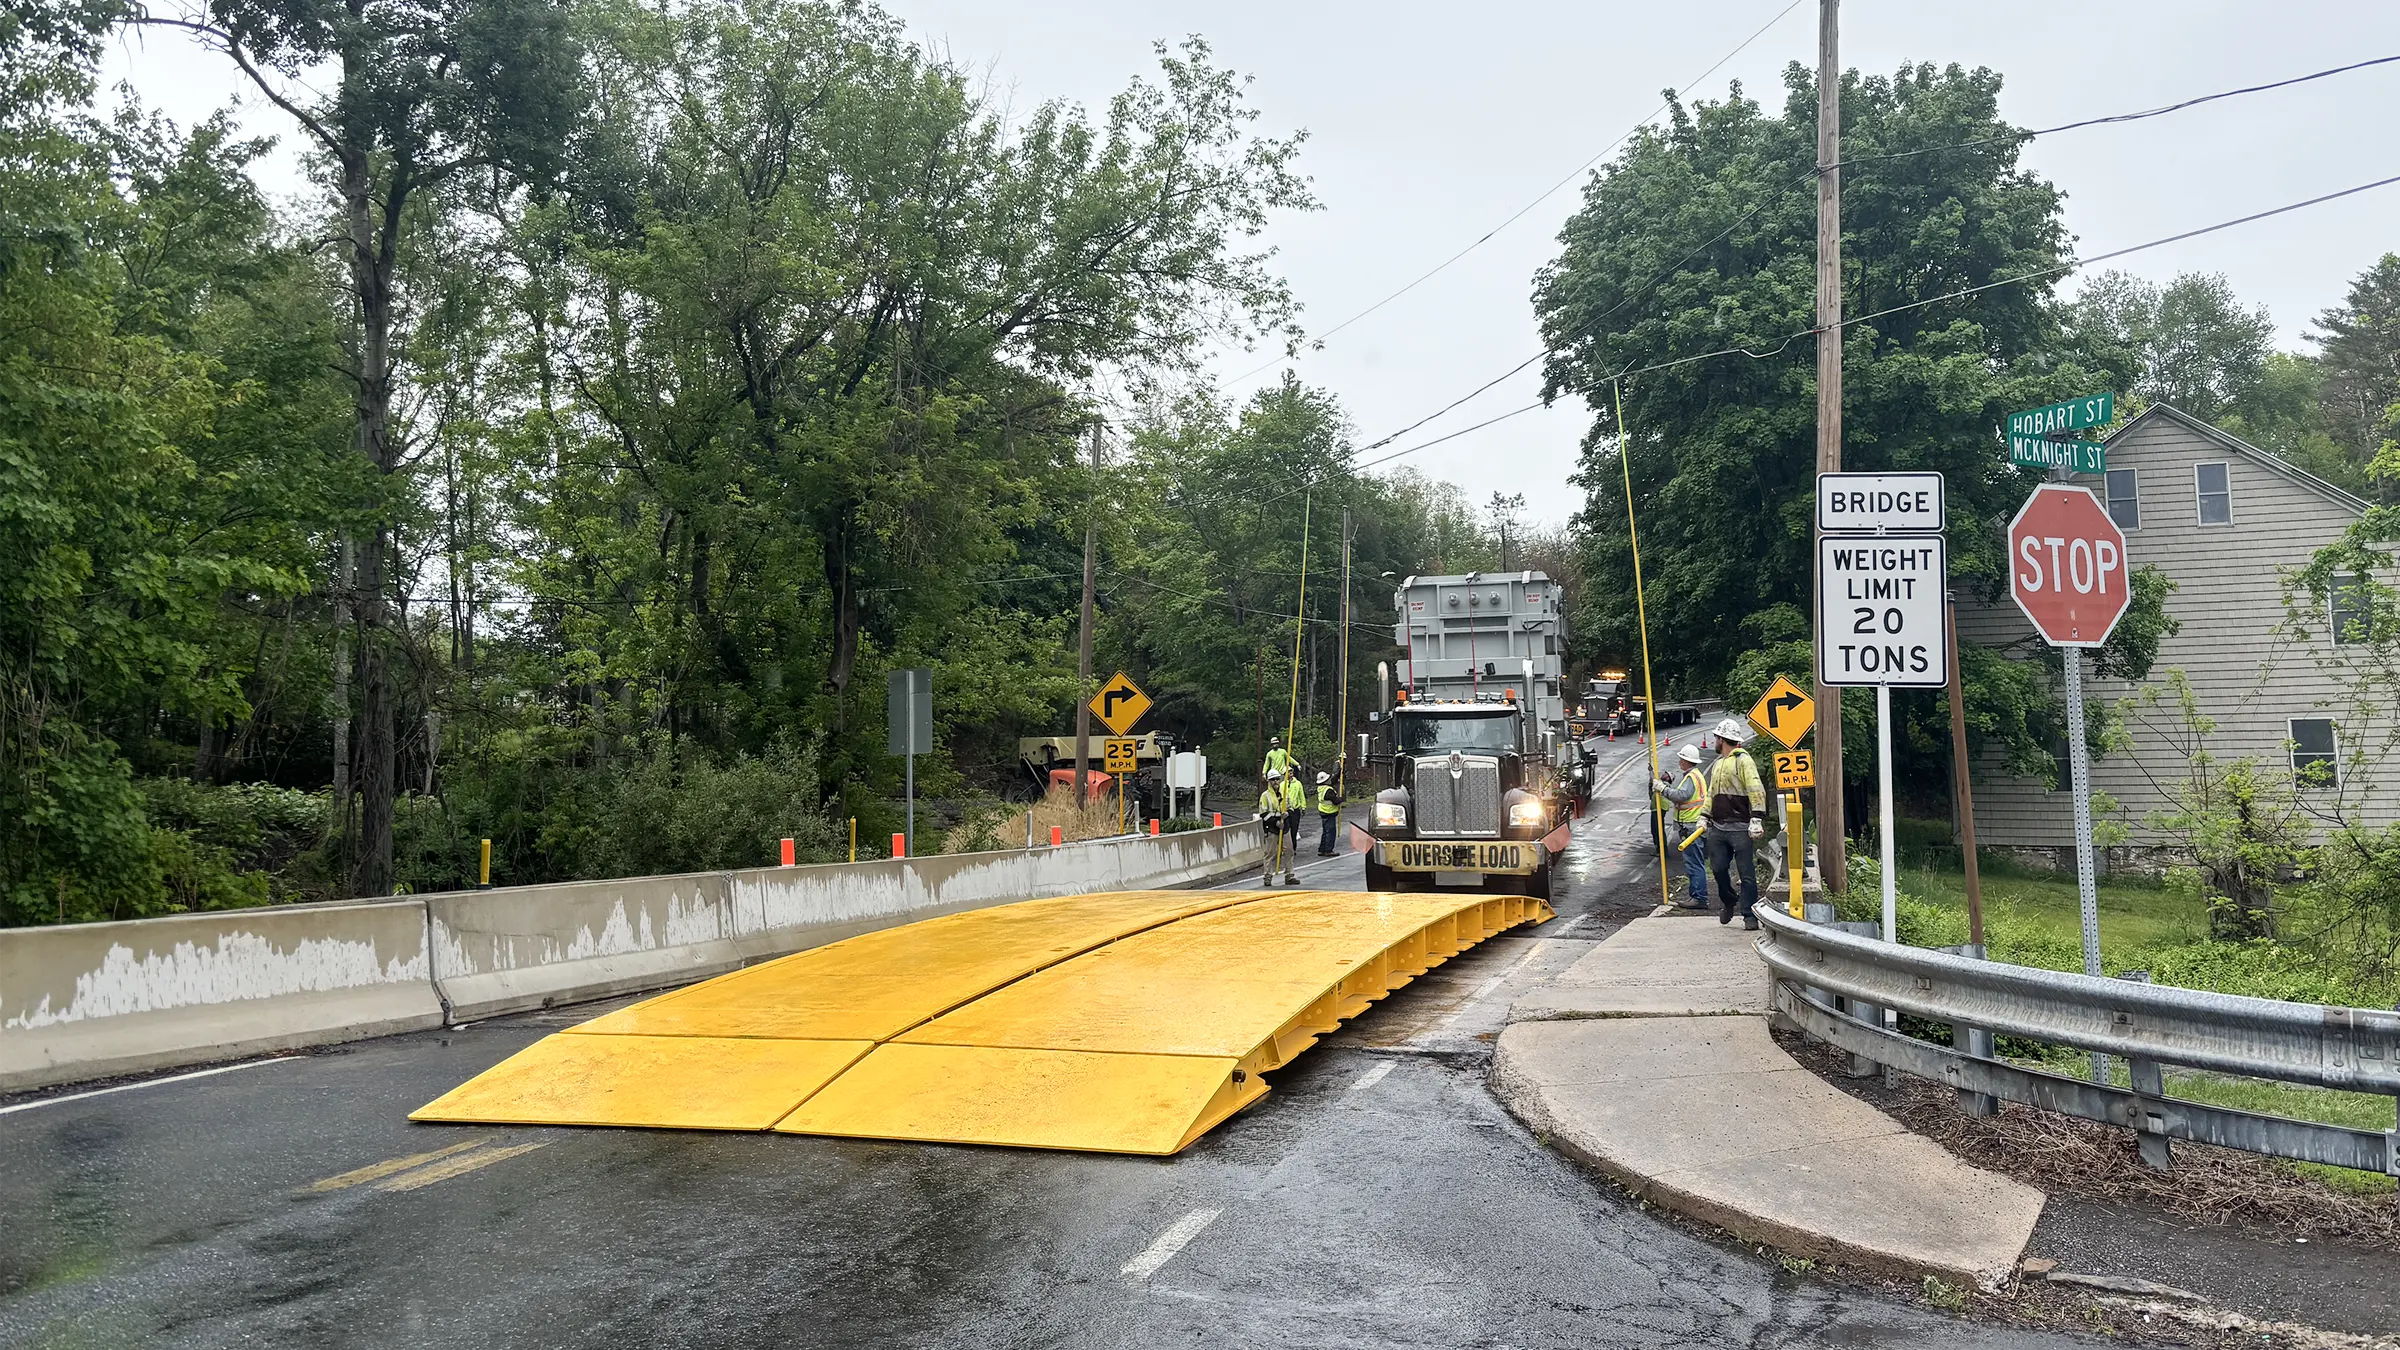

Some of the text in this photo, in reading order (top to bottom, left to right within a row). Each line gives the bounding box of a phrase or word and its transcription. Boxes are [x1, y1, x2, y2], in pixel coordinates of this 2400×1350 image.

[2013, 398, 2105, 435] HOBART ST
[2013, 436, 2102, 470] MCKNIGHT ST
[1831, 491, 1930, 513] BRIDGE
[1833, 549, 1933, 571] WEIGHT
[2019, 535, 2119, 594] STOP
[1847, 578, 1916, 600] LIMIT
[1853, 607, 1904, 634] 20
[1839, 645, 1929, 673] TONS
[1108, 744, 1134, 759] 25
[1778, 756, 1809, 773] 25
[1783, 776, 1810, 784] M.P.H.
[1480, 845, 1520, 869] LOAD
